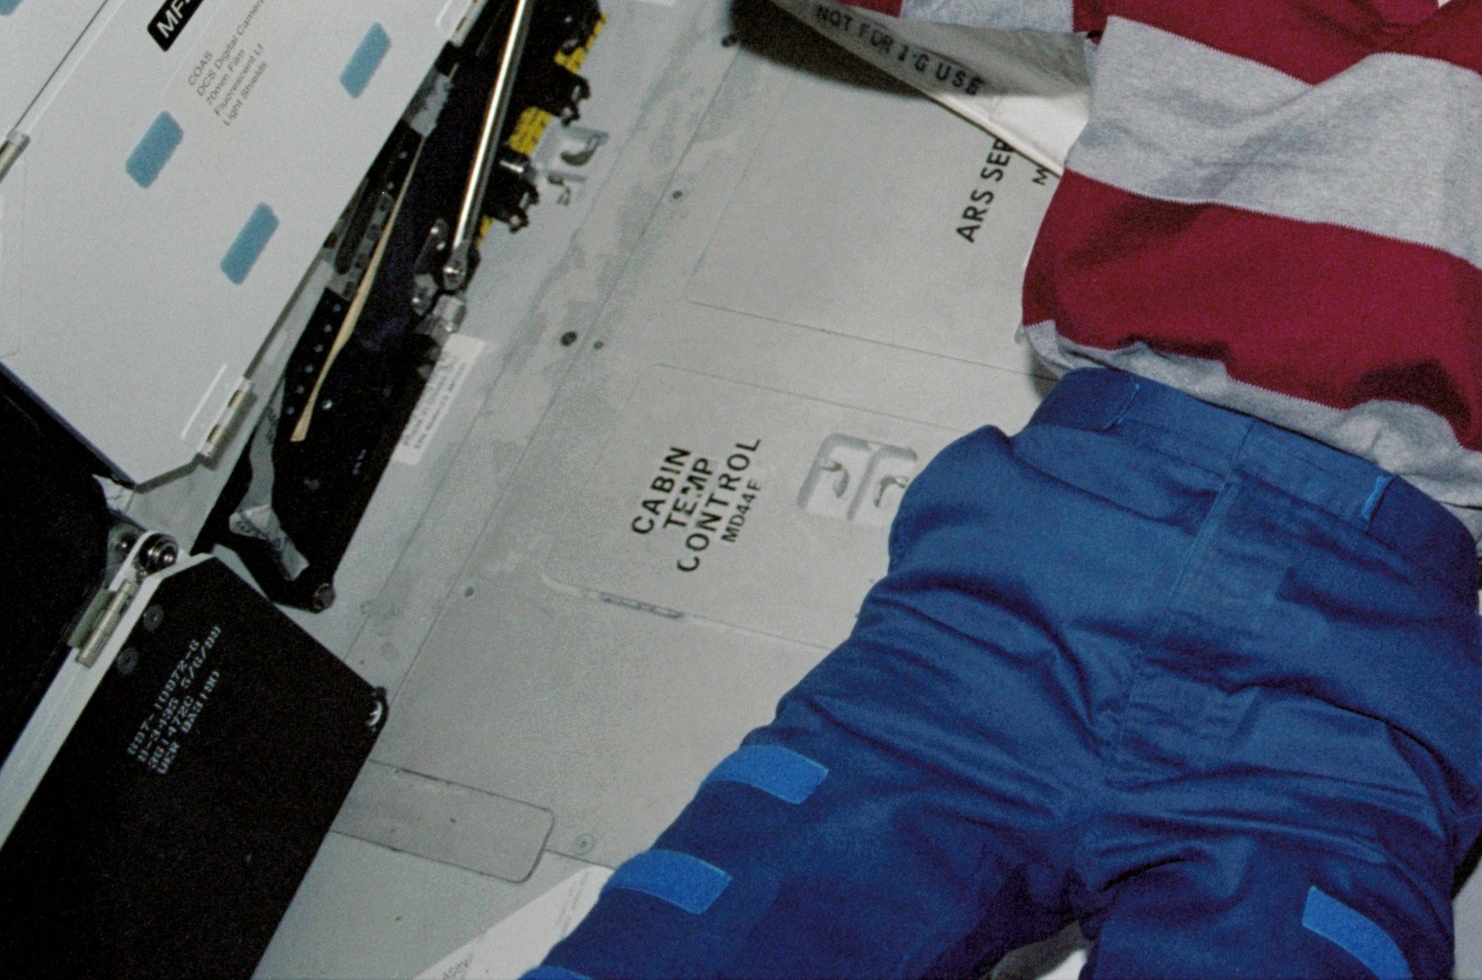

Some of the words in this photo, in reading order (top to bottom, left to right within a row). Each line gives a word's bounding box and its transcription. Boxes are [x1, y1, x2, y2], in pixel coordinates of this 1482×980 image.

[188, 51, 213, 87] COAS
[196, 69, 217, 97] DCS
[214, 36, 238, 70] Digital
[204, 72, 231, 106] 70mm
[228, 49, 245, 73] Film
[815, 5, 853, 32] NOT
[857, 23, 894, 53] FOR
[934, 65, 986, 96] USE
[214, 55, 257, 117] Fluorescent
[223, 98, 243, 127] Light
[241, 61, 268, 99] Shields
[956, 188, 995, 243] ARS
[631, 447, 691, 535] CABIN
[662, 458, 713, 529] TEMP
[677, 439, 762, 572] CONTROL
[721, 479, 761, 543] MD44F
